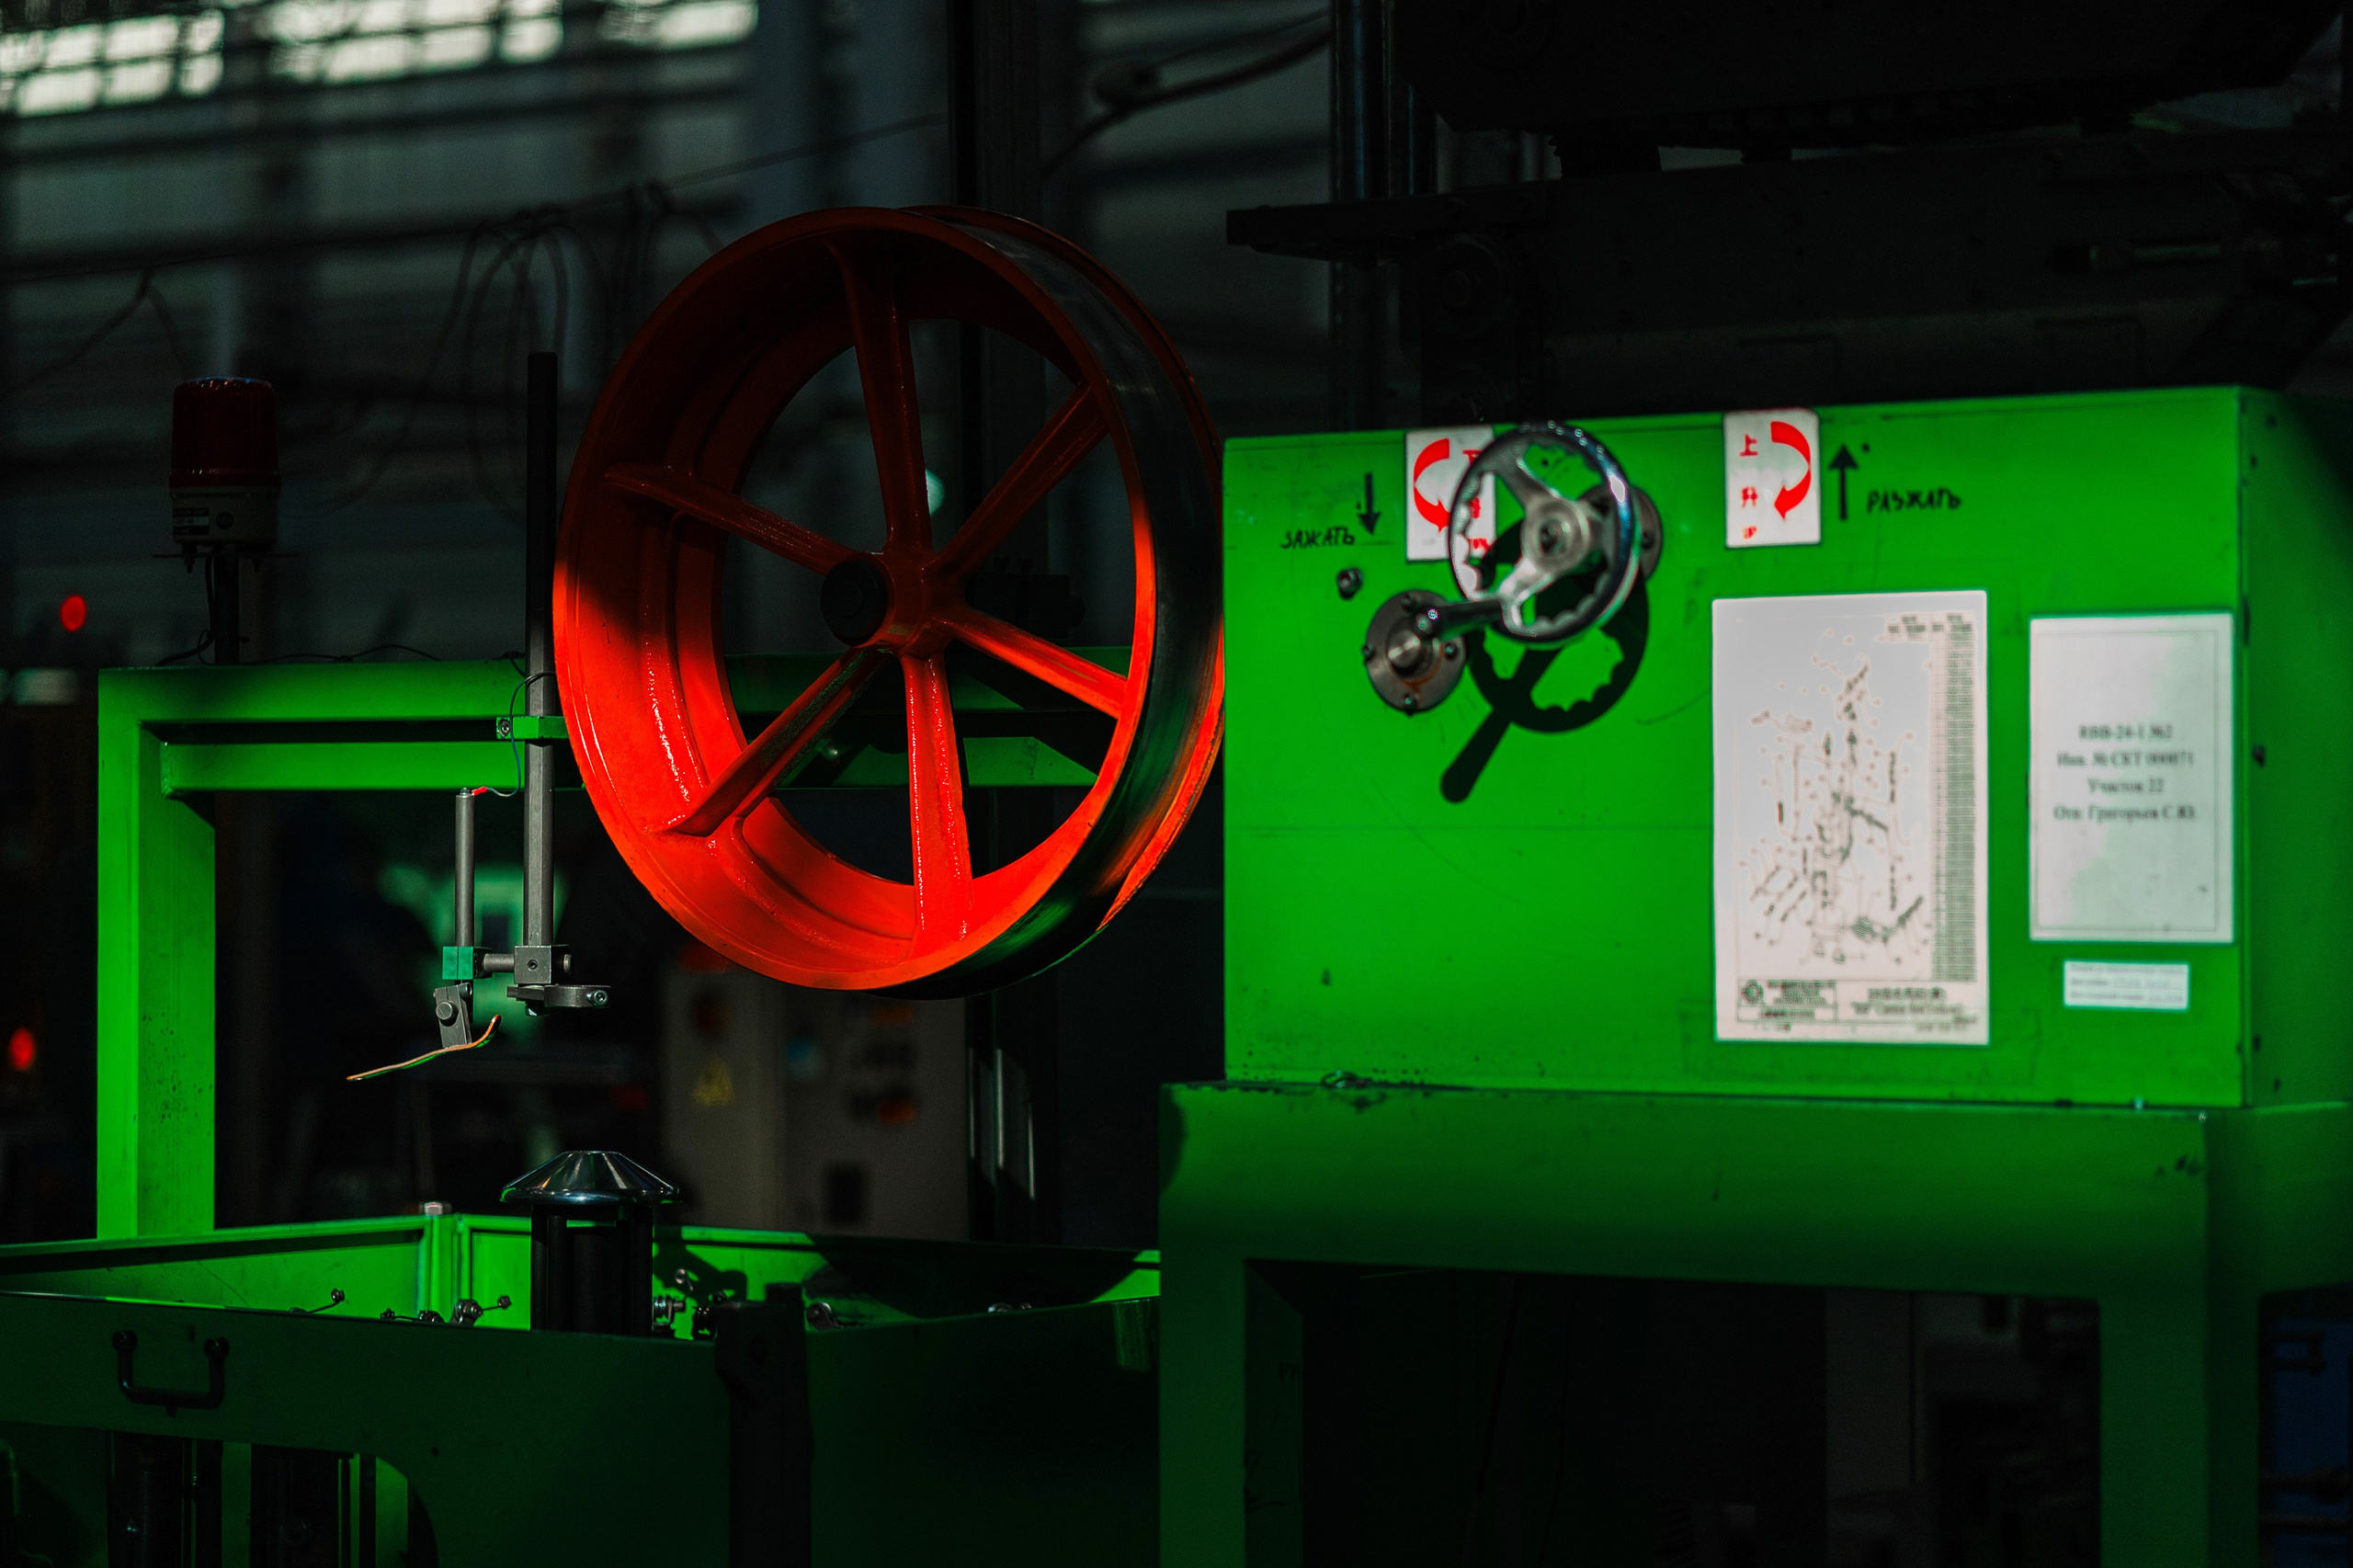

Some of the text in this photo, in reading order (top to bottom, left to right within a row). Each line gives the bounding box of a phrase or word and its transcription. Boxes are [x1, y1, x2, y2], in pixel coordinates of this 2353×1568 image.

[1867, 487, 1962, 514] РАЗЖАТЬ
[1280, 526, 1356, 550] ЗАЖАТЬ
[2087, 778, 2143, 794] Участок
